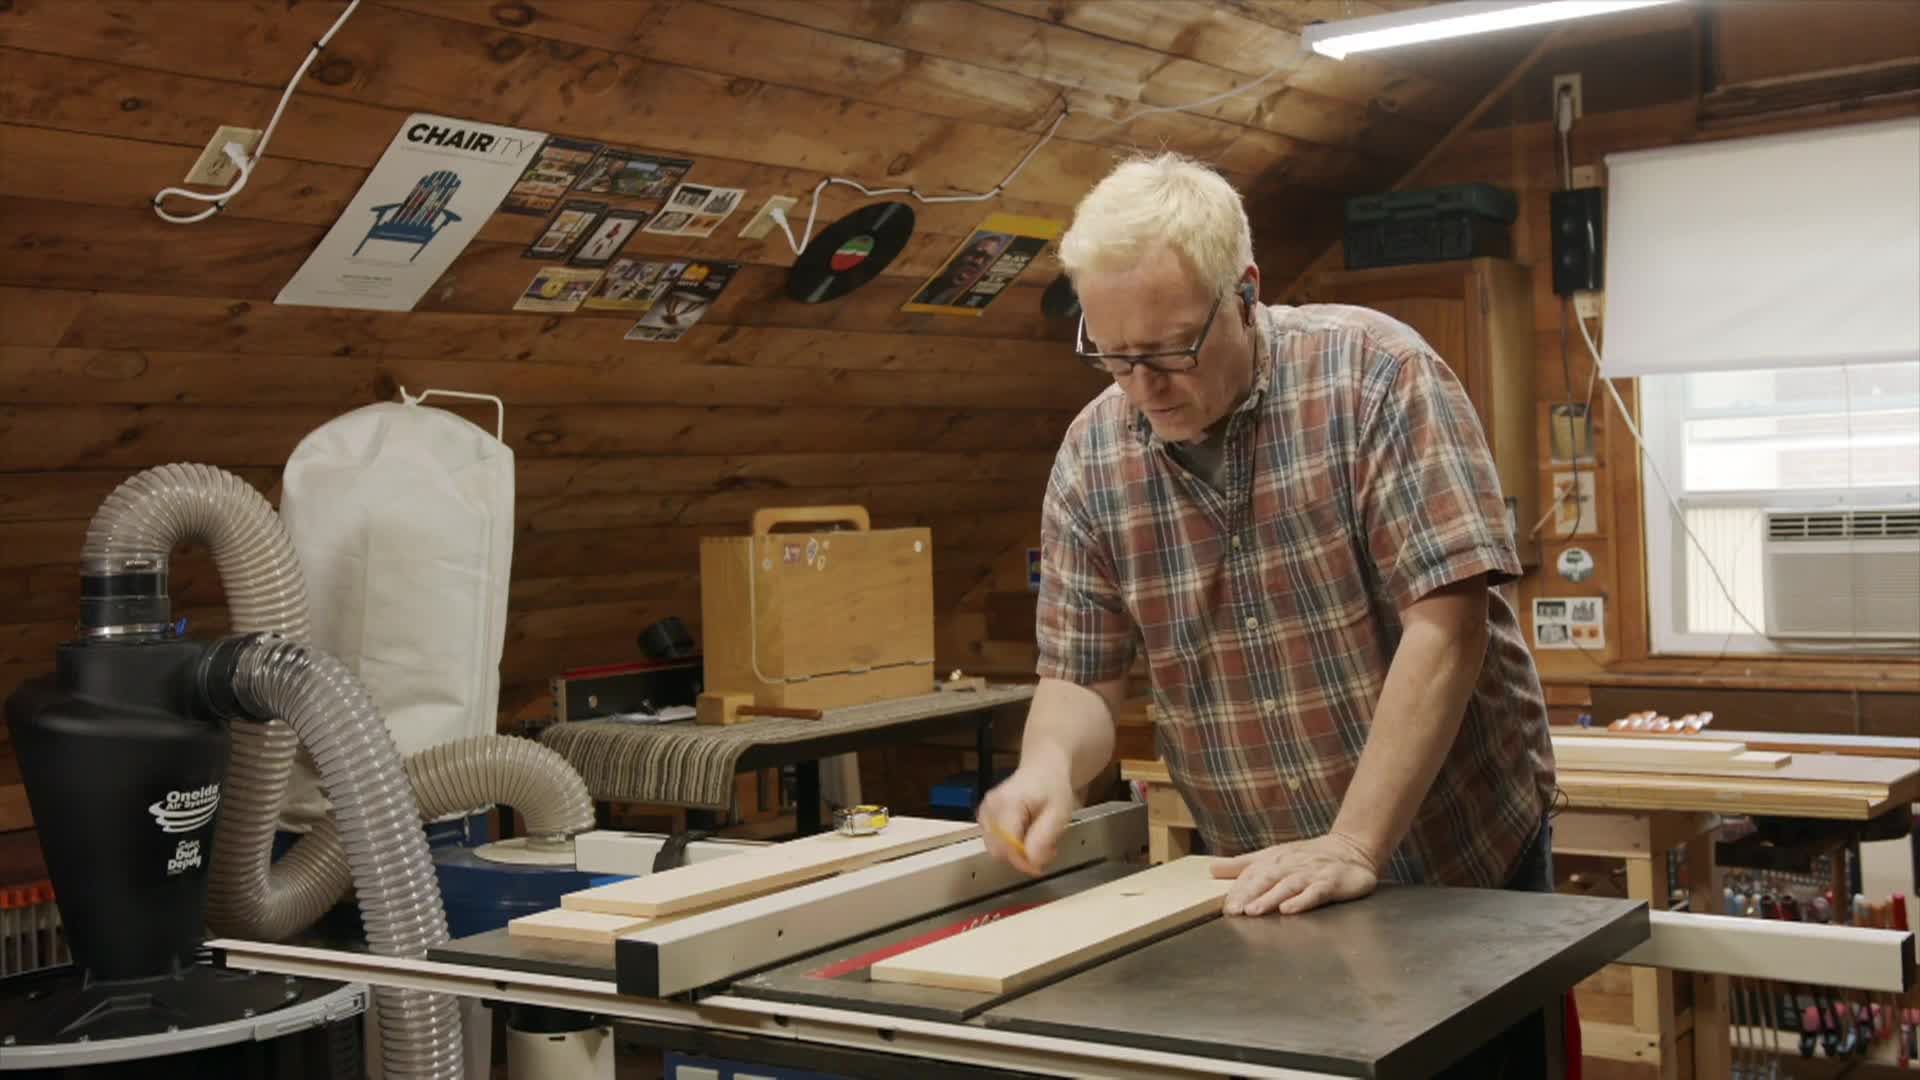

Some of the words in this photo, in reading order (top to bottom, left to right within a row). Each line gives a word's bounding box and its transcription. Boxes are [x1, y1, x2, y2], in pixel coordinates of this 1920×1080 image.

[407, 123, 535, 158] CHAIRITY
[166, 784, 219, 802] Oneida
[166, 801, 183, 810] Air
